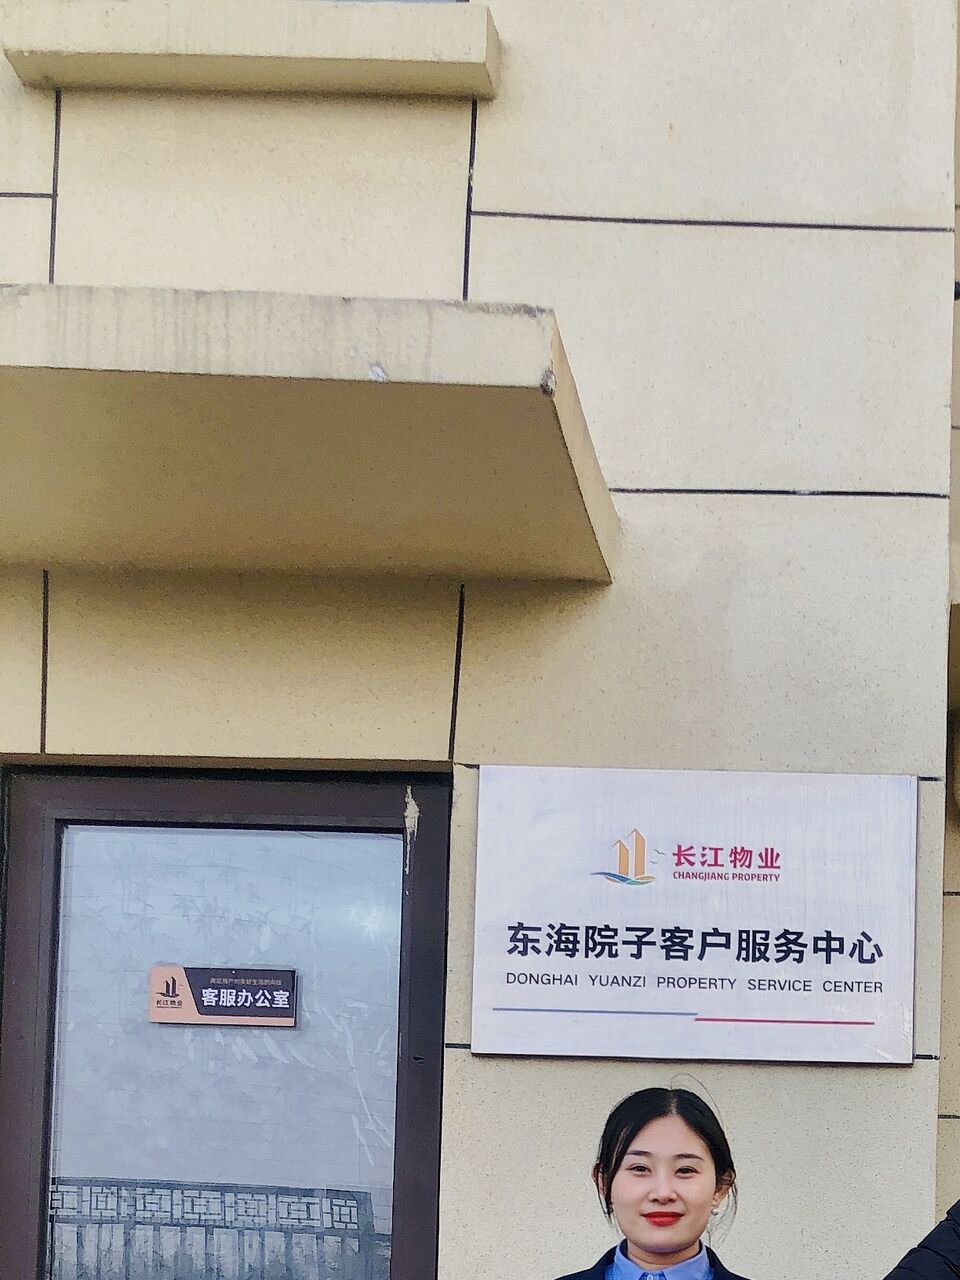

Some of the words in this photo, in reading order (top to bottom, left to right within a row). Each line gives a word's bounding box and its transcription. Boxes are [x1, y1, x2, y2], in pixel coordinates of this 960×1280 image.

[672, 844, 782, 870] 长江物业
[672, 870, 730, 882] CHANGJIANG
[731, 872, 781, 882] PROPERTY
[506, 922, 884, 965] 东海院子客户服务中心
[505, 972, 578, 987] DONGHAI
[588, 974, 646, 988] YUANZI
[657, 976, 737, 990] PROPERTY
[747, 978, 812, 992] SERVICE
[822, 980, 883, 993] CENTER
[201, 987, 290, 1008] 客服办公室
